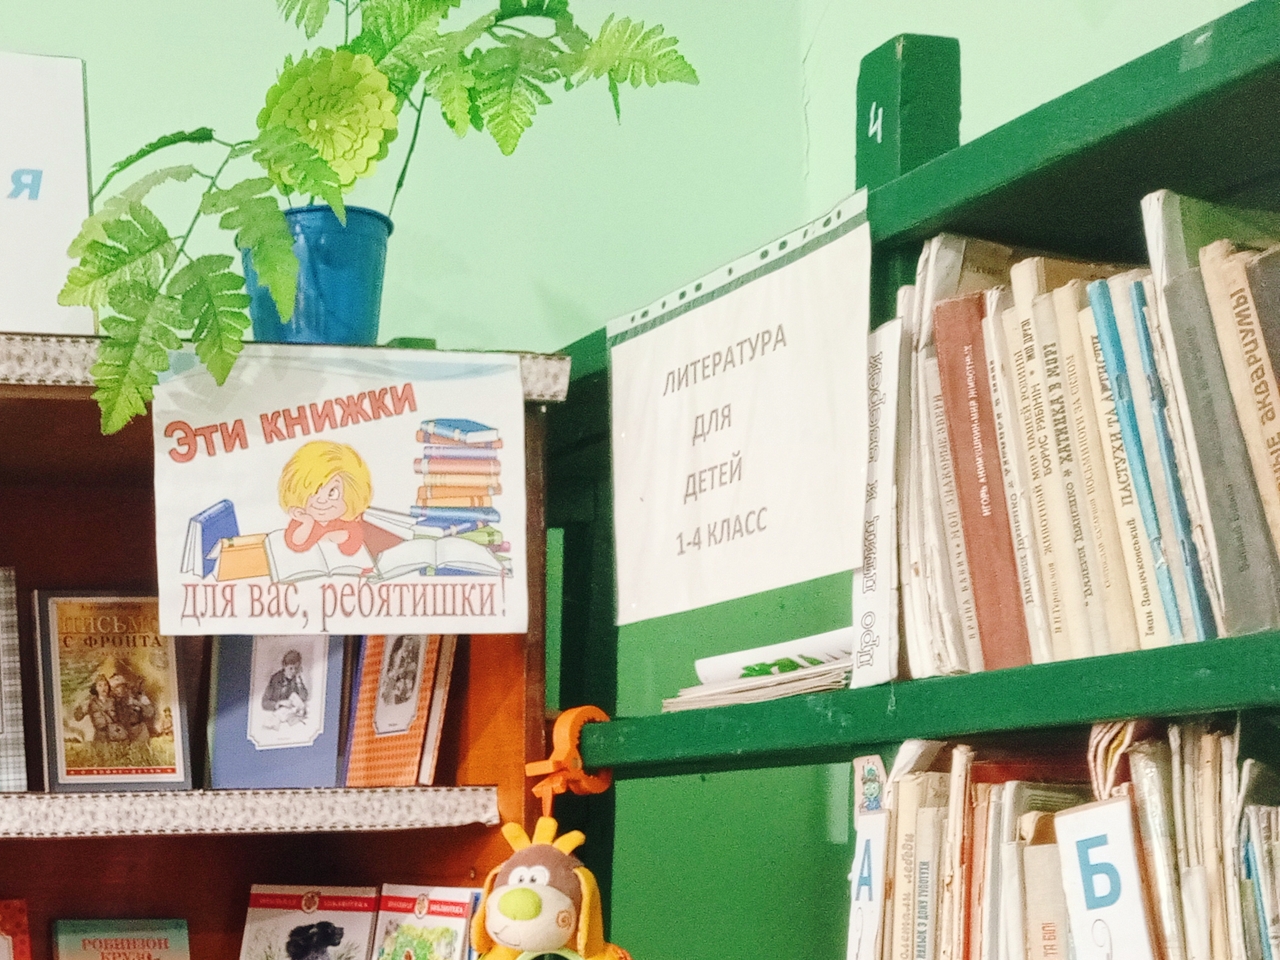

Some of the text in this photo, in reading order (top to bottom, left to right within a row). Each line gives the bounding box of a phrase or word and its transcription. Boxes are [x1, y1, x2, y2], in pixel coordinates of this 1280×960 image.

[867, 102, 884, 144] 4
[5, 167, 44, 201] я
[661, 331, 788, 397] ЛИТЕРАТУРА
[691, 405, 733, 447] ДЛЯ
[1015, 350, 1052, 556] ЖИВОТНЫЙ МИР НАШЕЙ РОДИНЫ
[1039, 435, 1051, 477] БОРИС
[1111, 431, 1133, 507] ПАСТУХИ
[682, 456, 744, 505] ДЕТЕЙ
[675, 506, 768, 558] 1-4 КЛАСС
[179, 576, 509, 633] для вас, ребятишки!
[855, 838, 873, 902] А
[1075, 834, 1121, 911] Б
[81, 938, 169, 951] РОБИНЗОН
[1043, 944, 1055, 958] ТА
